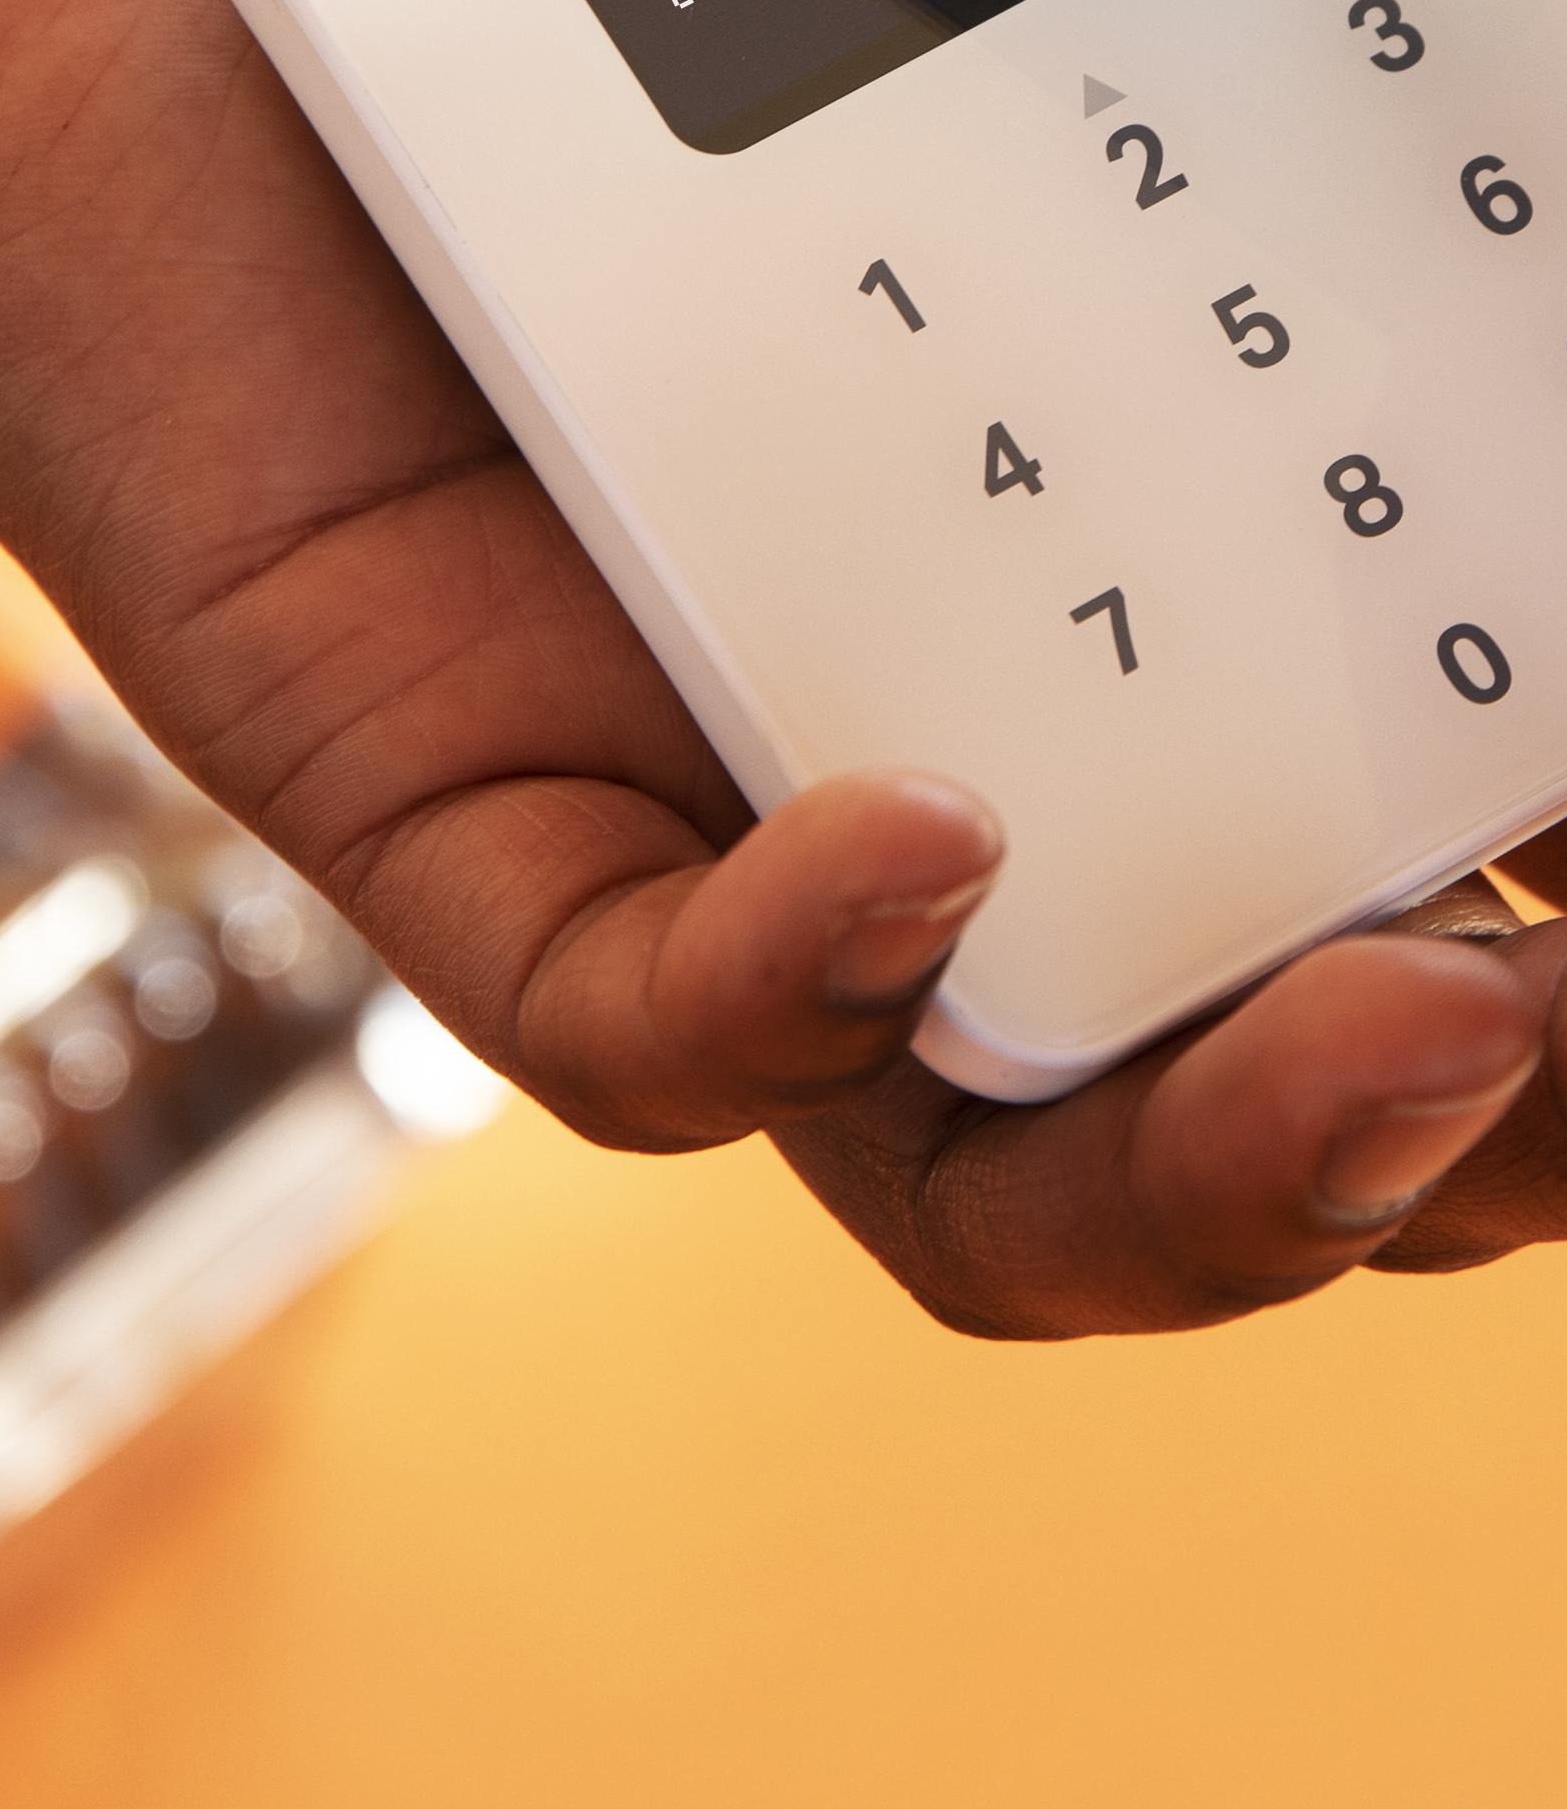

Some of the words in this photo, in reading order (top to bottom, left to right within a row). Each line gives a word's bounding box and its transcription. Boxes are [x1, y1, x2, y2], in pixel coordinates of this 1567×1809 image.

[858, 258, 926, 333] 1
[1106, 124, 1189, 210] 2
[982, 421, 1045, 498] 4
[1211, 283, 1290, 369] 5
[1460, 154, 1533, 236] 6
[1069, 586, 1140, 675] 7
[1323, 454, 1404, 538] 8
[1436, 622, 1512, 705] 0
